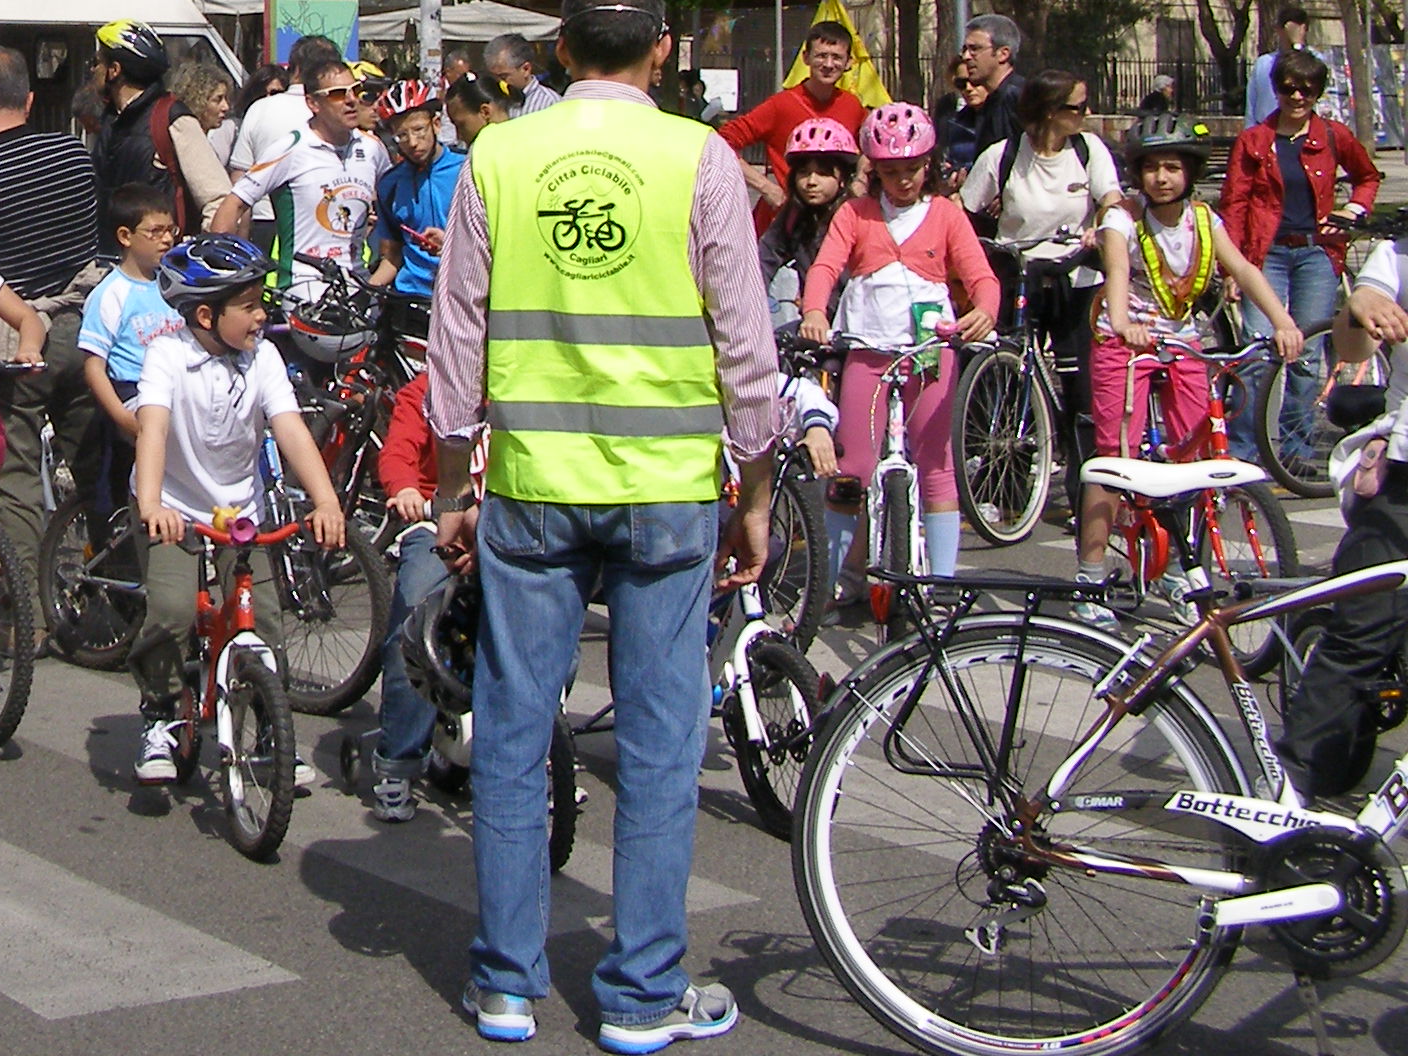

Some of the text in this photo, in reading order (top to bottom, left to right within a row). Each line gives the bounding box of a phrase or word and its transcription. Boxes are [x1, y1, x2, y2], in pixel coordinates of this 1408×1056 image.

[548, 165, 631, 195] Città Ciclabile
[569, 253, 608, 266] Cagliari
